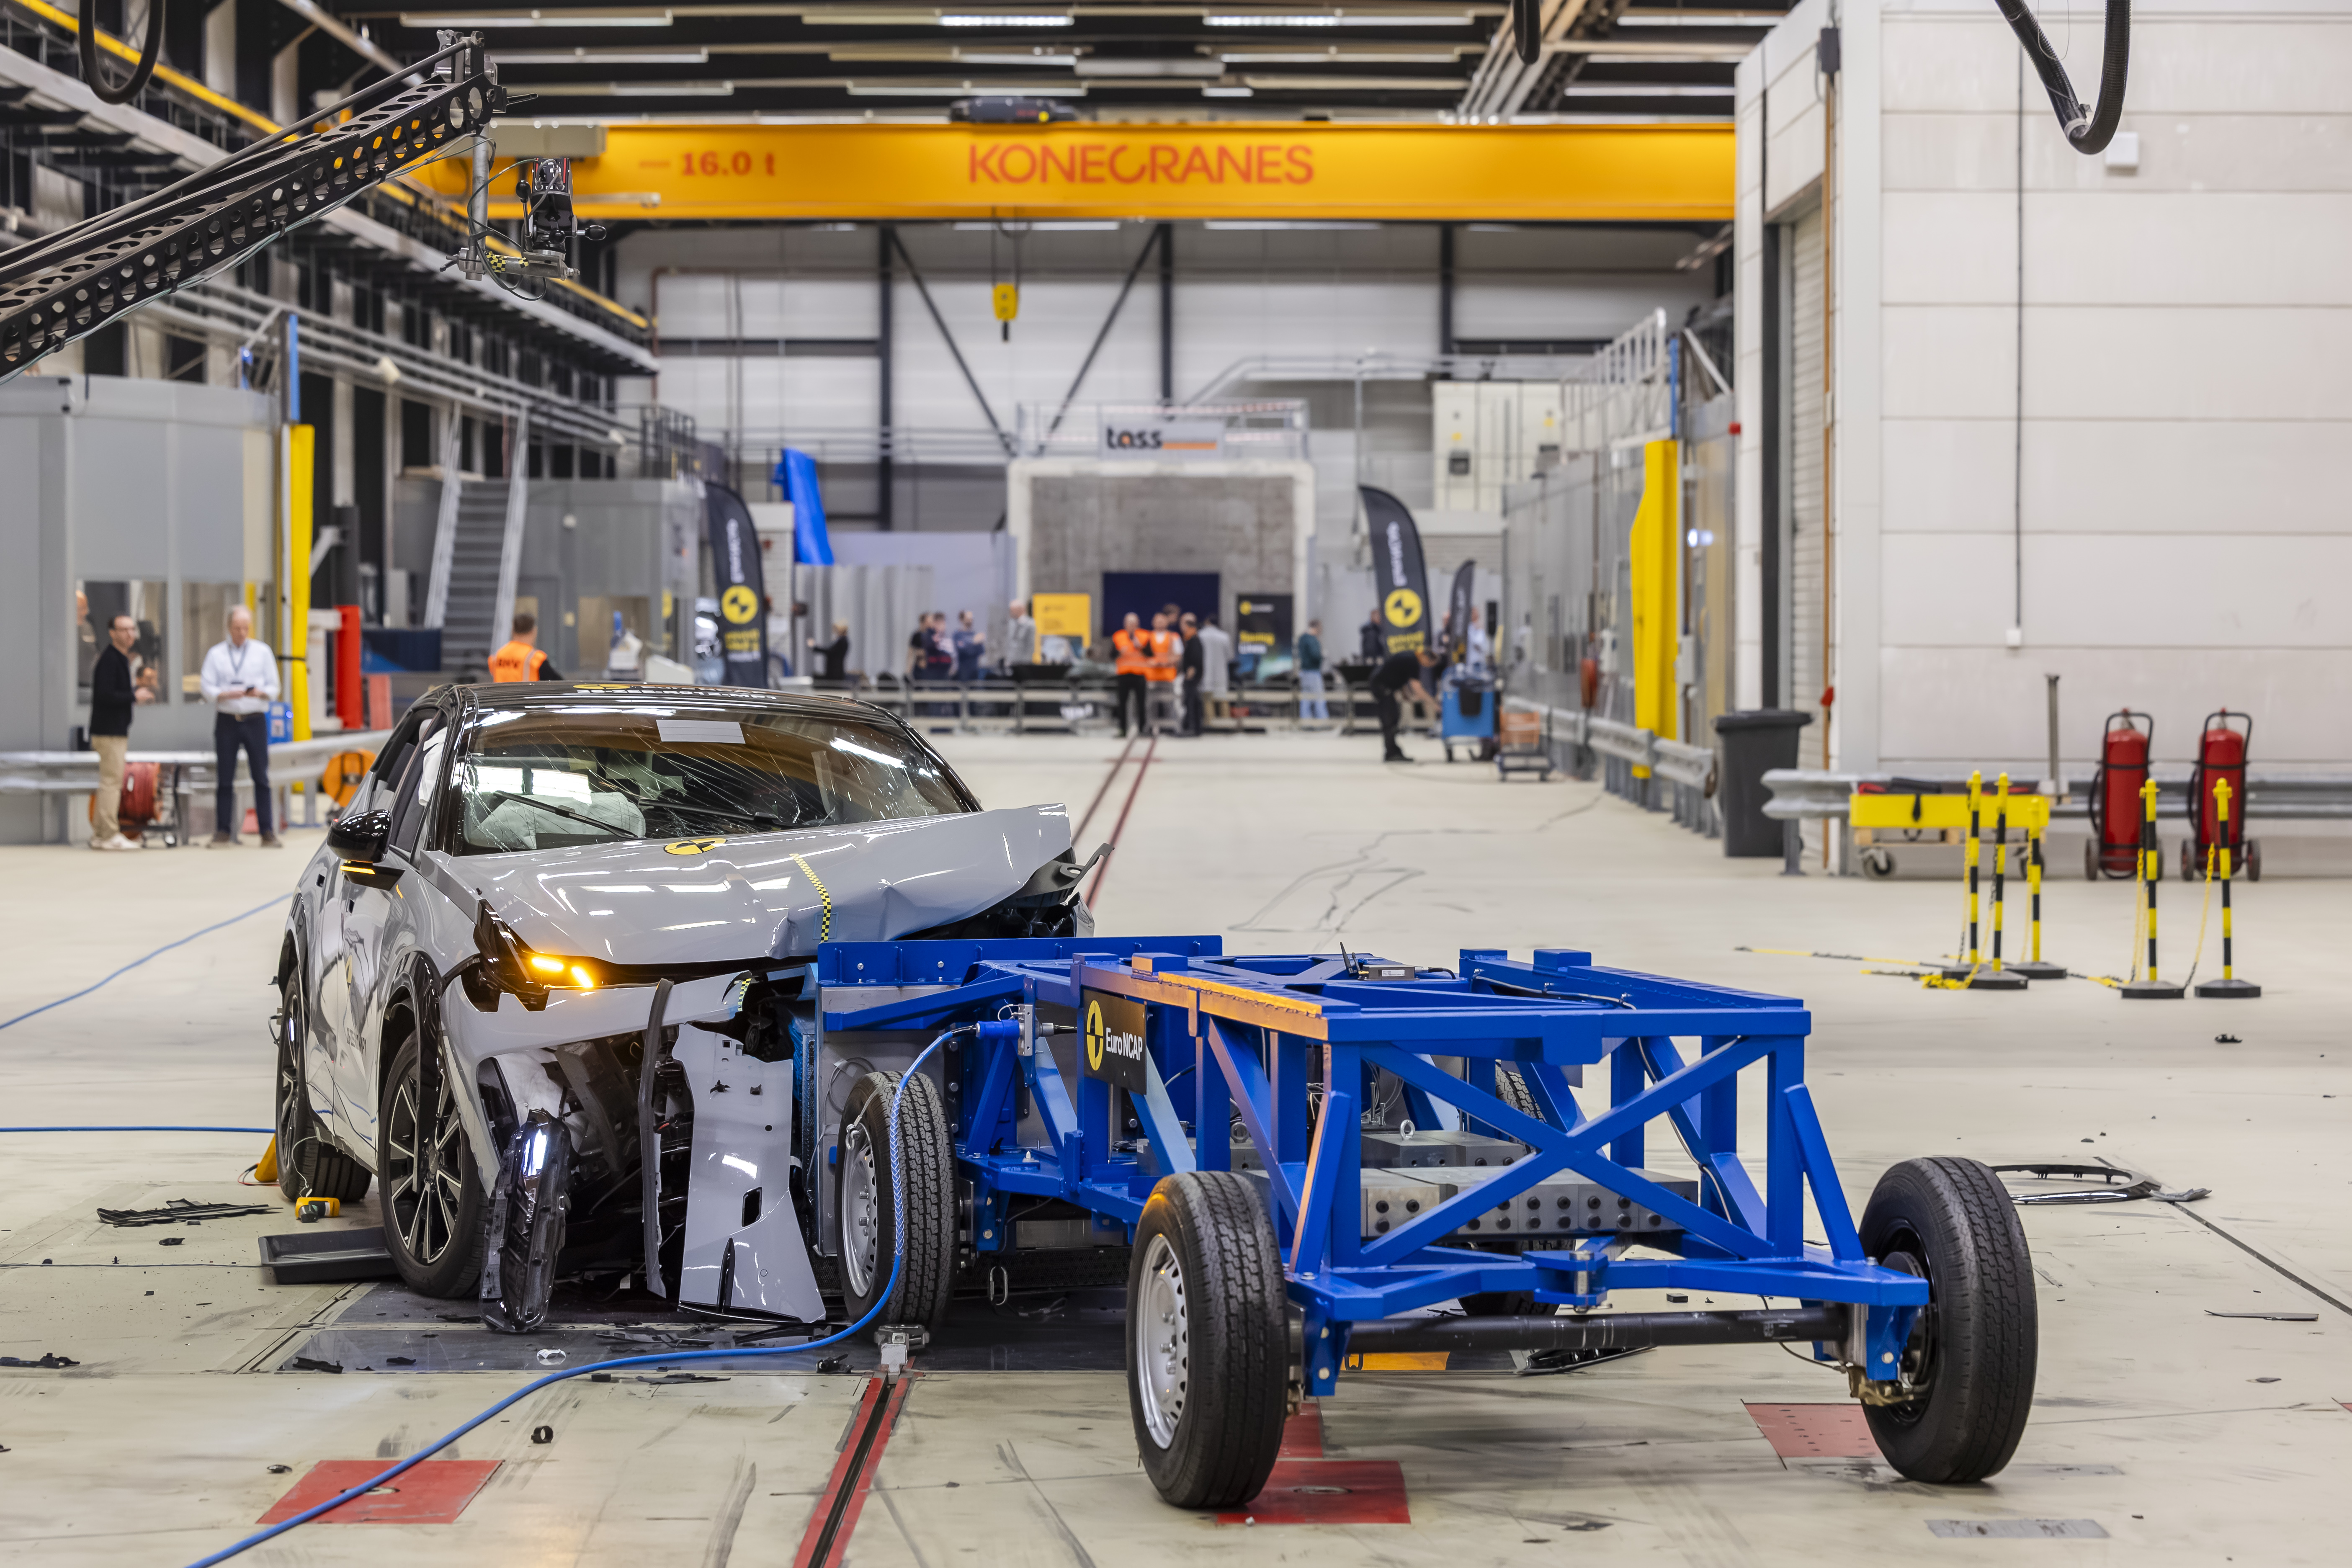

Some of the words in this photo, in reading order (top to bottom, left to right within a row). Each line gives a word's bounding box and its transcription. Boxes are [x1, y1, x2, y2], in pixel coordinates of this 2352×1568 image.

[683, 150, 752, 176] 16.0
[969, 144, 1314, 185] KONECRANES
[1107, 426, 1163, 449] tass
